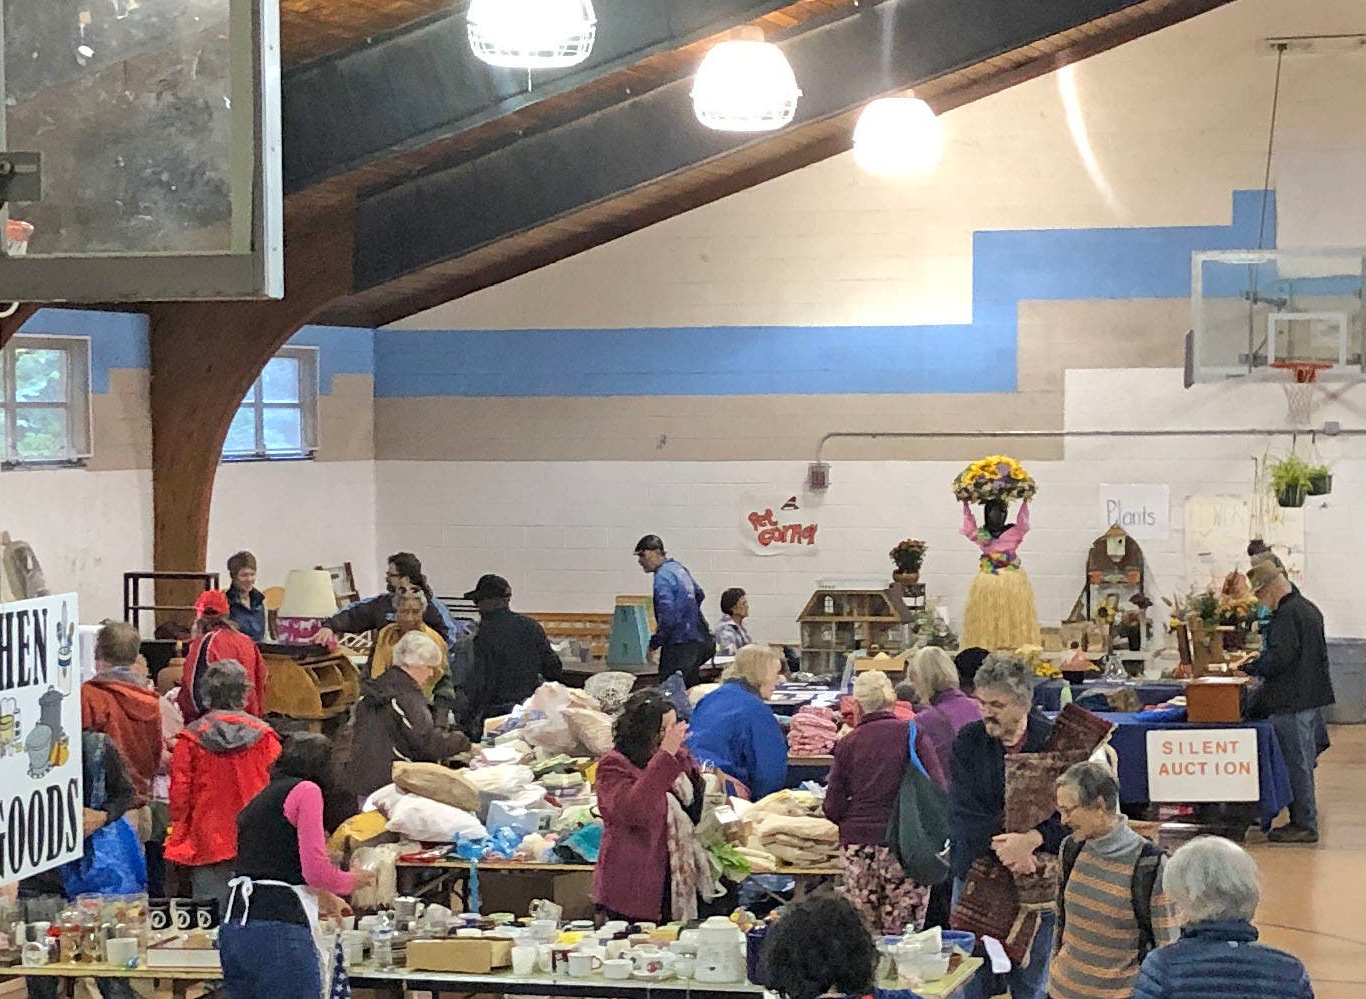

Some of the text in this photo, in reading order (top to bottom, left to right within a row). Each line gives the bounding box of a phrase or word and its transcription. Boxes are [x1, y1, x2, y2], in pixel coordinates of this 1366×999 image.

[1107, 499, 1156, 527] Plants
[1161, 741, 1239, 755] SILENT
[1159, 761, 1251, 776] AUCTION
